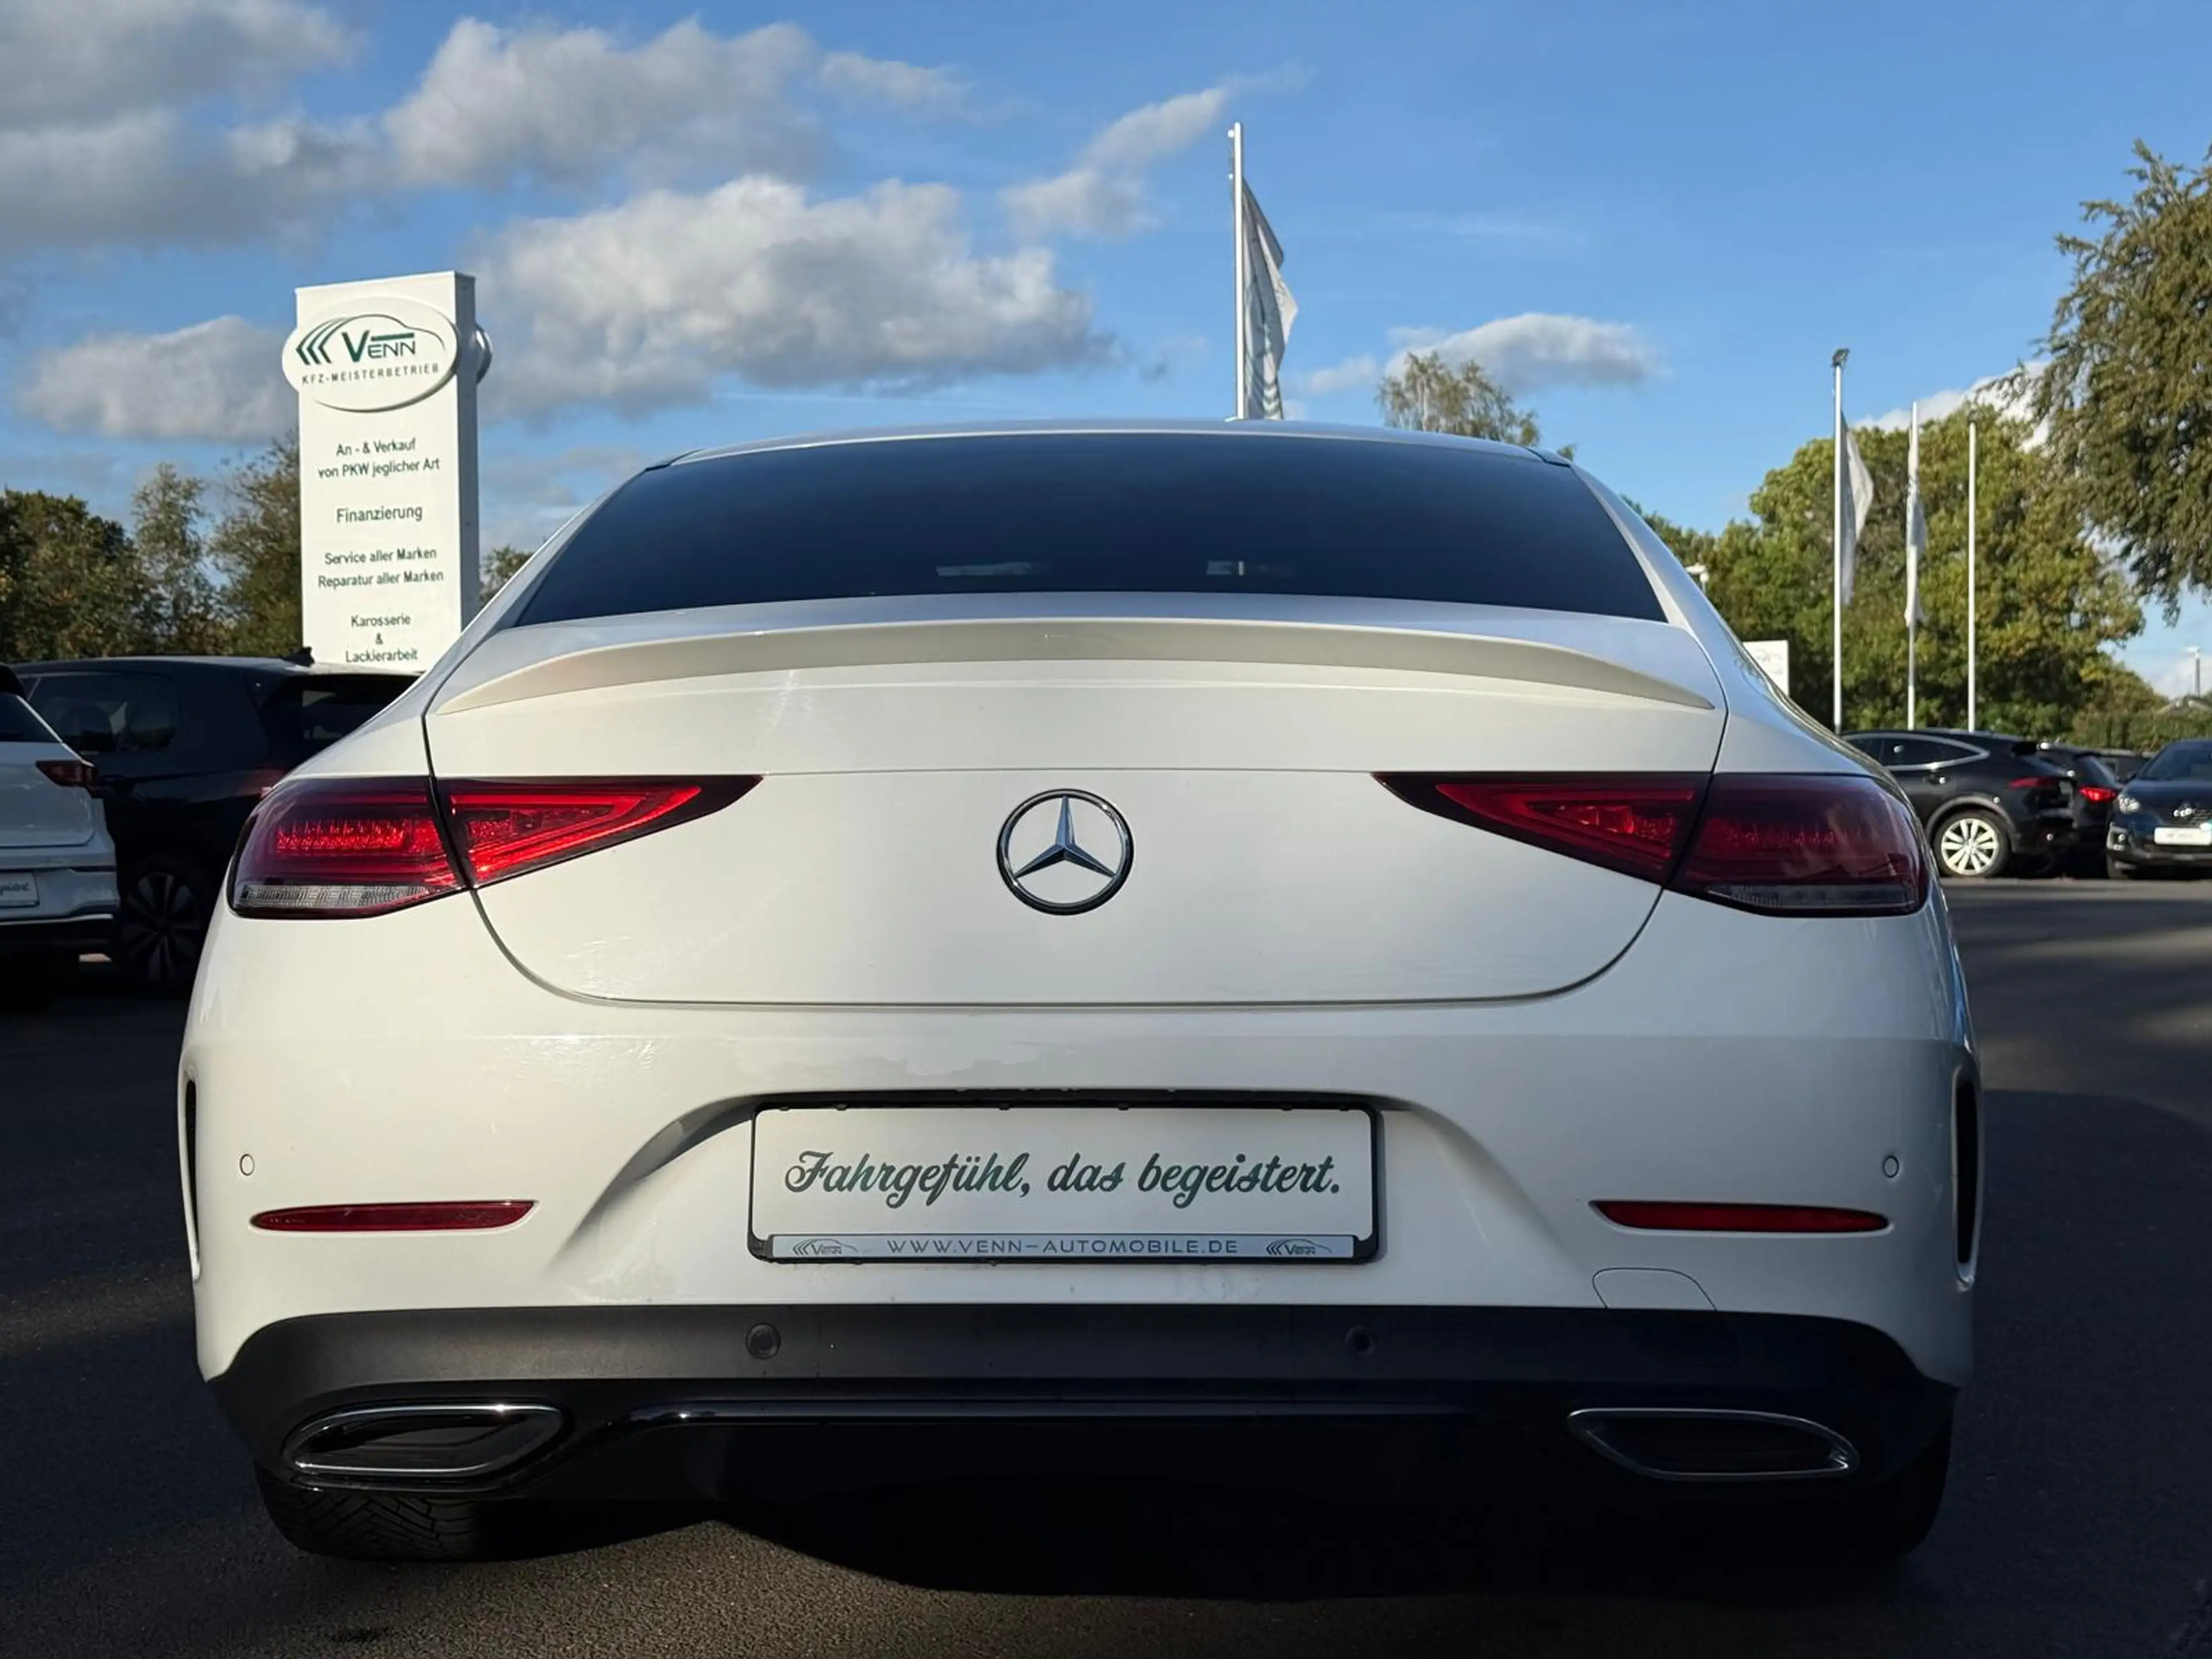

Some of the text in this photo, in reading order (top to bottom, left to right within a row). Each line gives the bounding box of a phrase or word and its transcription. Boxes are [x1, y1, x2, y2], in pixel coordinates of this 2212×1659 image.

[302, 363, 440, 385] KFZ-MEISTERBETRIEB
[336, 444, 352, 456] An
[362, 442, 371, 454] &
[374, 437, 416, 453] Verkauf
[318, 457, 440, 478] von PKW jeglicher Art
[336, 506, 423, 523] Finanzierung
[324, 547, 437, 565] Service aller Marken
[318, 569, 444, 589] Reparatur aller Marken
[351, 613, 411, 627] Karosserie
[376, 633, 384, 645] &
[346, 648, 418, 663] Lackierarbeit
[785, 1150, 1340, 1209] Fahrgefühl, das begeistert.
[887, 1238, 1238, 1254] WWW.VENN-AUTOMOBILE.DE
